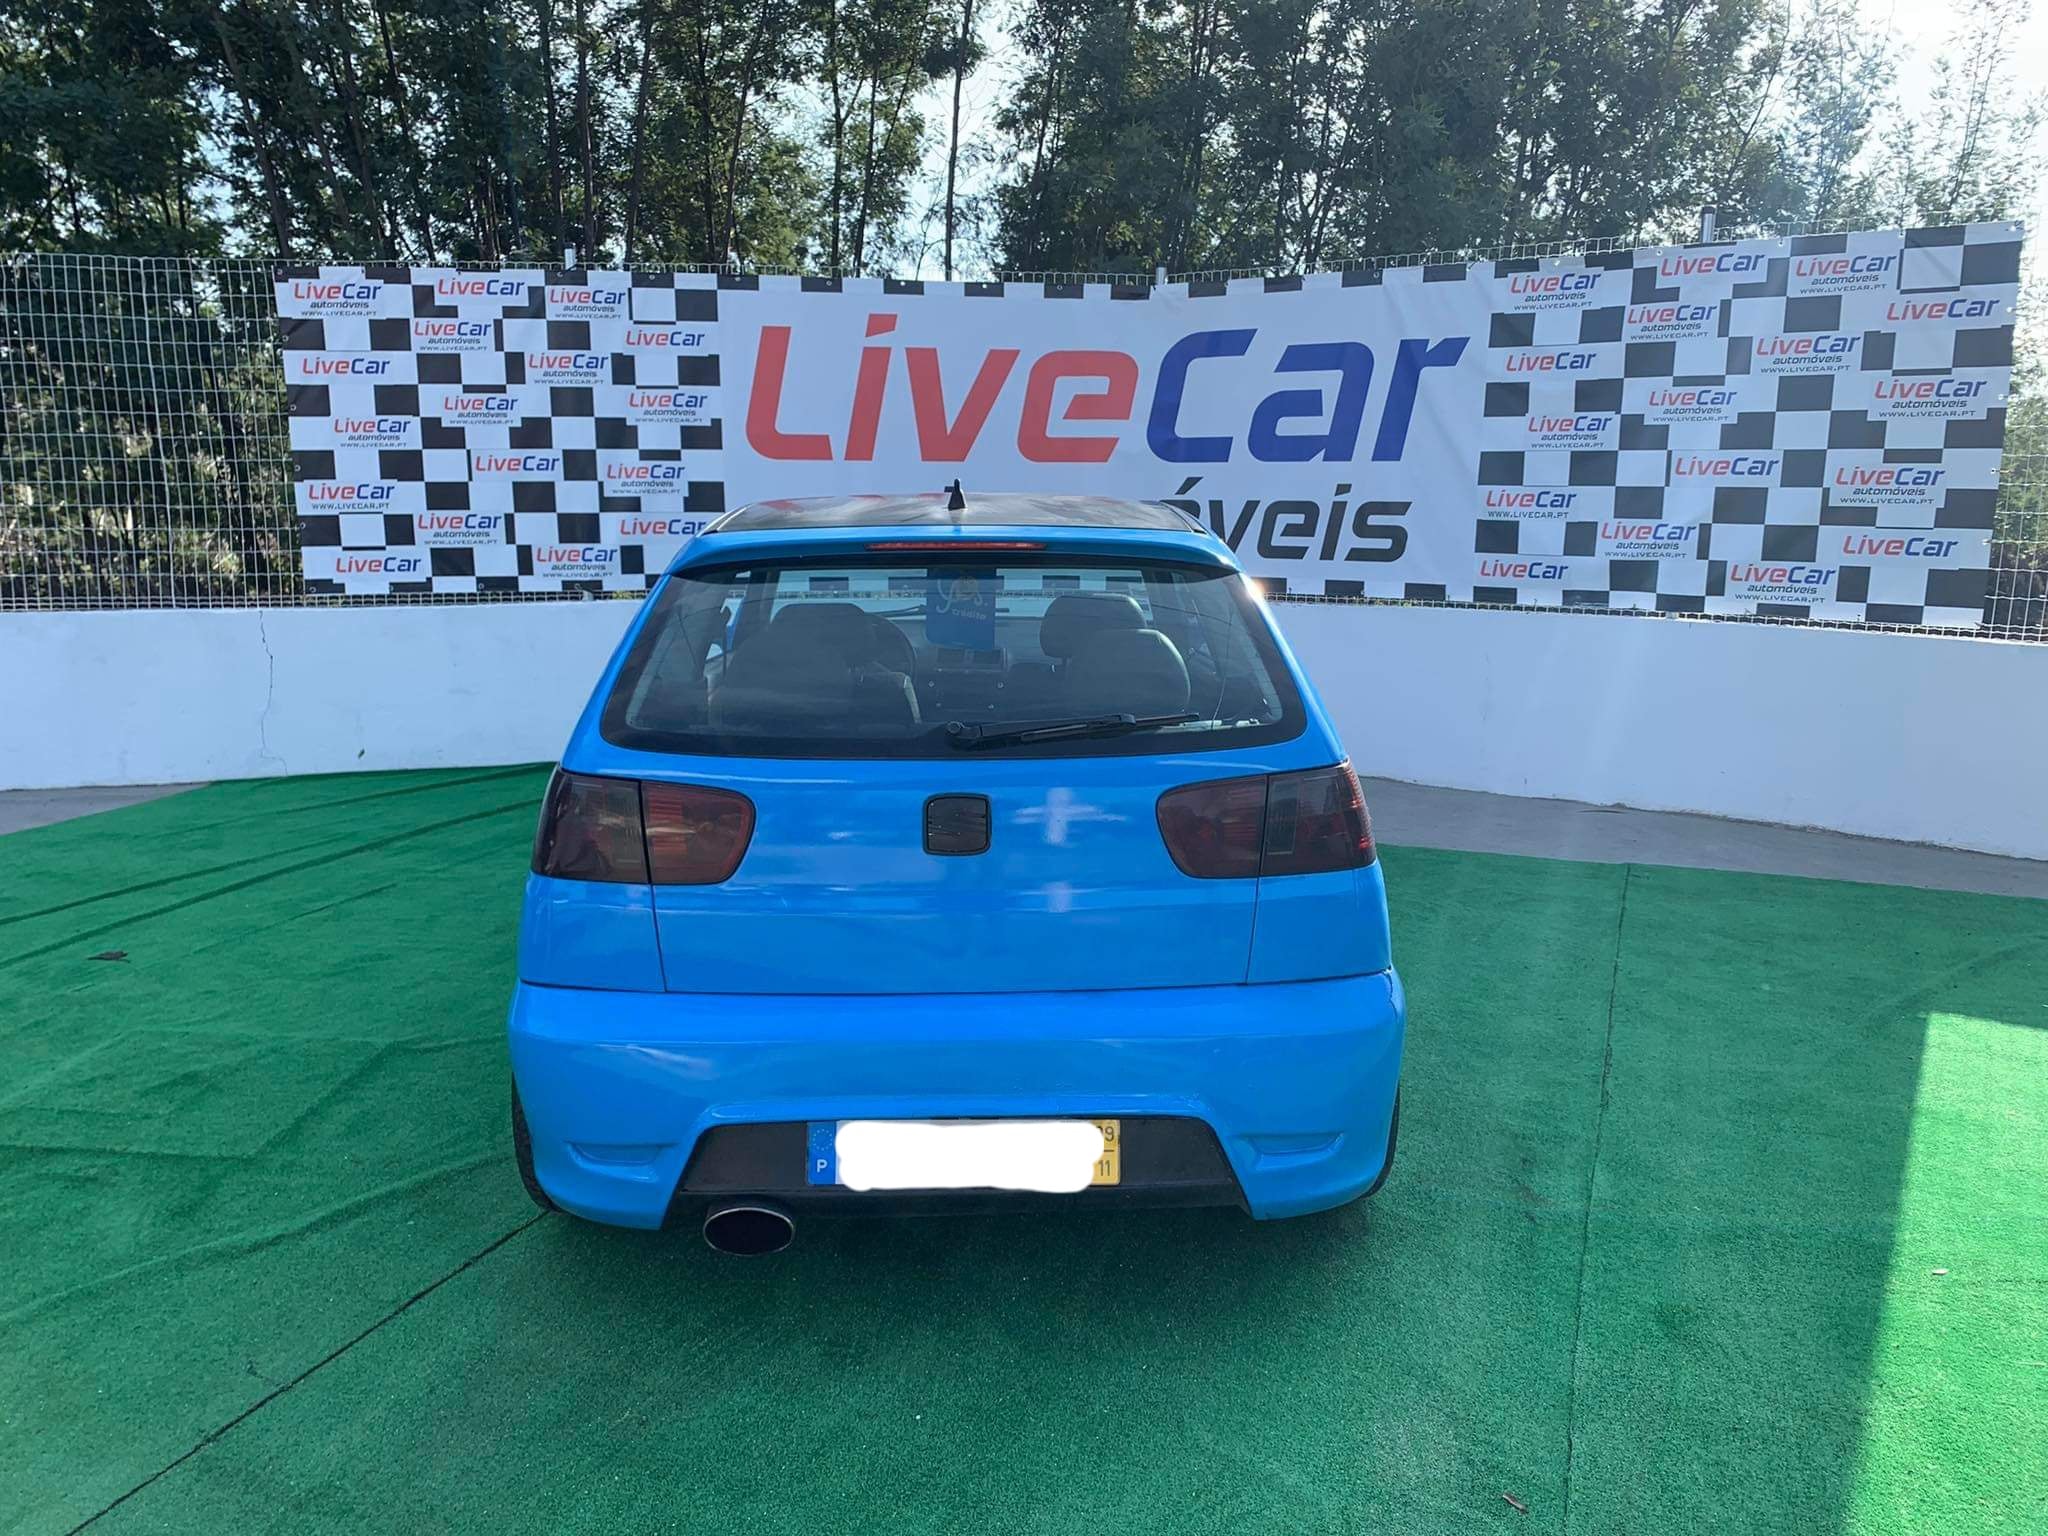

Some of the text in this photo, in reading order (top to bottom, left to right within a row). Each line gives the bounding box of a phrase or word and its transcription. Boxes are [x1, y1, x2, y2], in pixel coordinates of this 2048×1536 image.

[1661, 253, 1765, 276] LiveCar
[1796, 254, 1897, 276] LiveCar
[438, 279, 524, 295] LiveCar
[1511, 273, 1601, 293] LiveCar
[1812, 274, 1879, 285] automóveis
[294, 282, 381, 299] LiveCar
[550, 288, 625, 305] LiveCar
[1525, 291, 1585, 302] automóveis
[1628, 305, 1717, 324] LiveCar
[1887, 299, 1999, 320] LiveCar
[415, 320, 491, 336] LiveCar
[1640, 322, 1701, 332] automóveis
[626, 330, 704, 346] LiveCar
[1757, 336, 1860, 356] LiveCar
[303, 358, 390, 374] LiveCar
[529, 353, 608, 369] LiveCar
[1506, 352, 1596, 371] LiveCar
[1773, 354, 1842, 364] automóveis
[745, 313, 1470, 462] LiveCar
[1875, 379, 1987, 399] LiveCar
[444, 396, 518, 411] LiveCar
[630, 392, 707, 408] LiveCar
[1649, 389, 1737, 406] LiveCar
[1892, 399, 1967, 408] automóveis
[1663, 406, 1721, 414] automóveis
[334, 418, 410, 433] LiveCar
[1528, 416, 1612, 432] LiveCar
[1541, 433, 1597, 441] automóveis
[476, 455, 559, 472] LiveCar
[607, 463, 684, 479] LiveCar
[1675, 457, 1779, 476] LiveCar
[1836, 466, 1945, 486] LiveCar
[309, 483, 394, 500] LiveCar
[1486, 490, 1576, 508] LiveCar
[1853, 486, 1925, 496] automóveis
[418, 513, 501, 529] LiveCar
[1602, 522, 1696, 541] LiveCar
[537, 546, 617, 562] LiveCar
[1616, 542, 1679, 550] automóveis
[1843, 536, 1959, 557] LiveCar
[336, 557, 421, 572] LiveCar
[1481, 560, 1568, 579] LiveCar
[1731, 564, 1835, 584] LiveCar
[1747, 584, 1817, 595] automóveis
[1096, 1126, 1114, 1142] 9
[816, 1159, 827, 1172] P
[1098, 1160, 1110, 1176] 11
